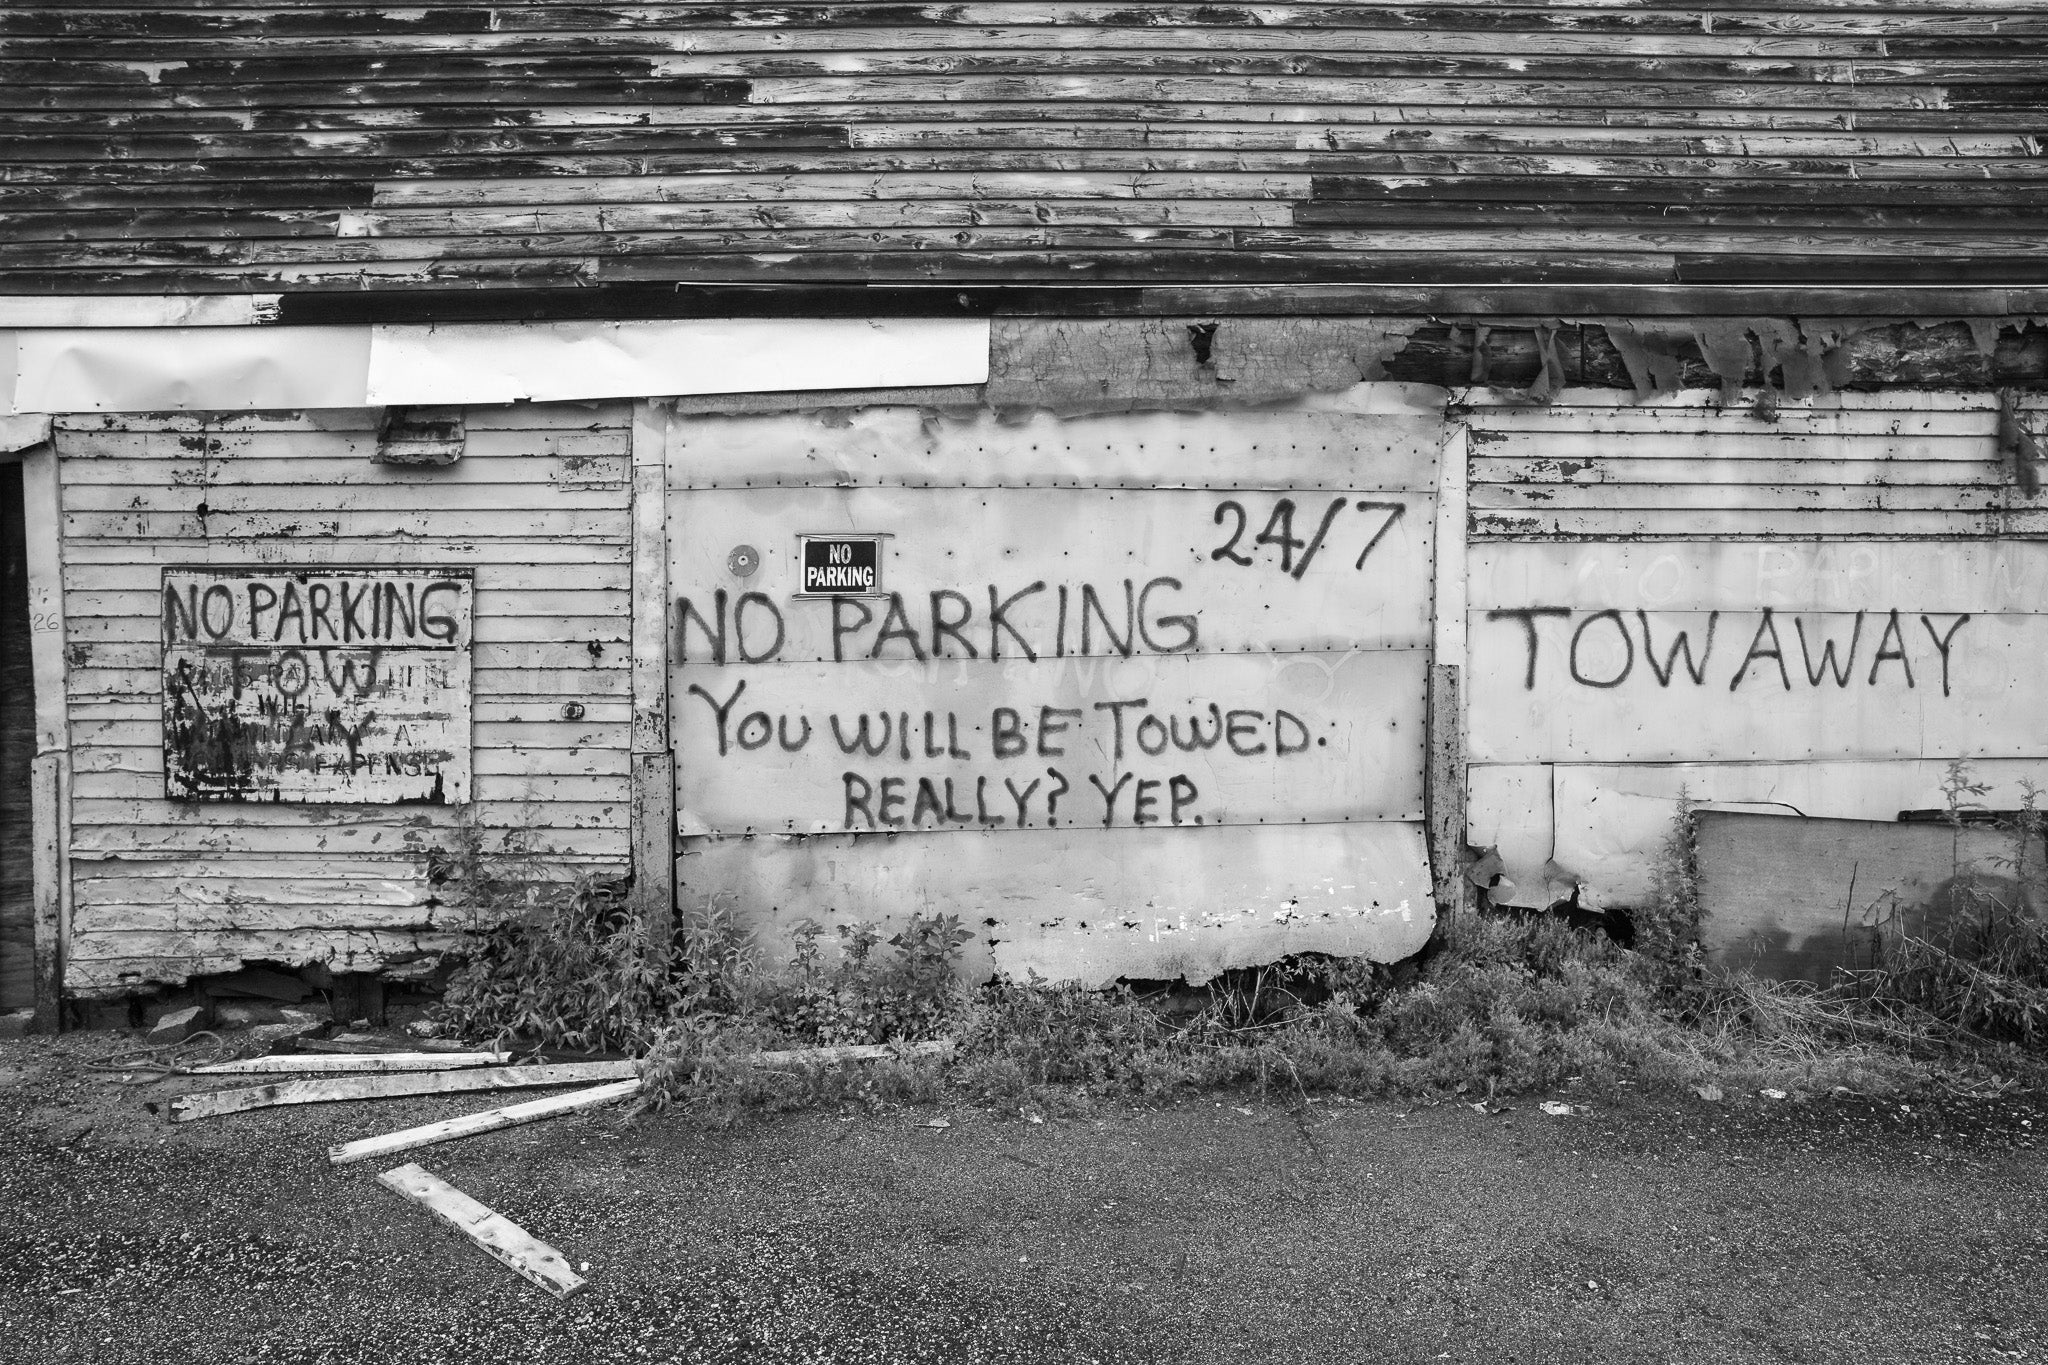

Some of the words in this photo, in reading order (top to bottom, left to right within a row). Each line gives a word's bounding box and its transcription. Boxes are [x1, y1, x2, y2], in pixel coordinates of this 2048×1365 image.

[829, 543, 852, 565] NO
[1211, 498, 1407, 580] 24/7
[807, 566, 874, 587] PARKING
[34, 613, 59, 631] 26
[164, 579, 234, 642] NO
[247, 580, 462, 644] PARKING
[673, 588, 786, 667] NO
[831, 577, 1199, 663] PARKING
[831, 711, 971, 761] WILL
[992, 707, 1082, 758] BE
[843, 767, 1069, 829] REALLY?
[1090, 769, 1205, 829] YEP.
